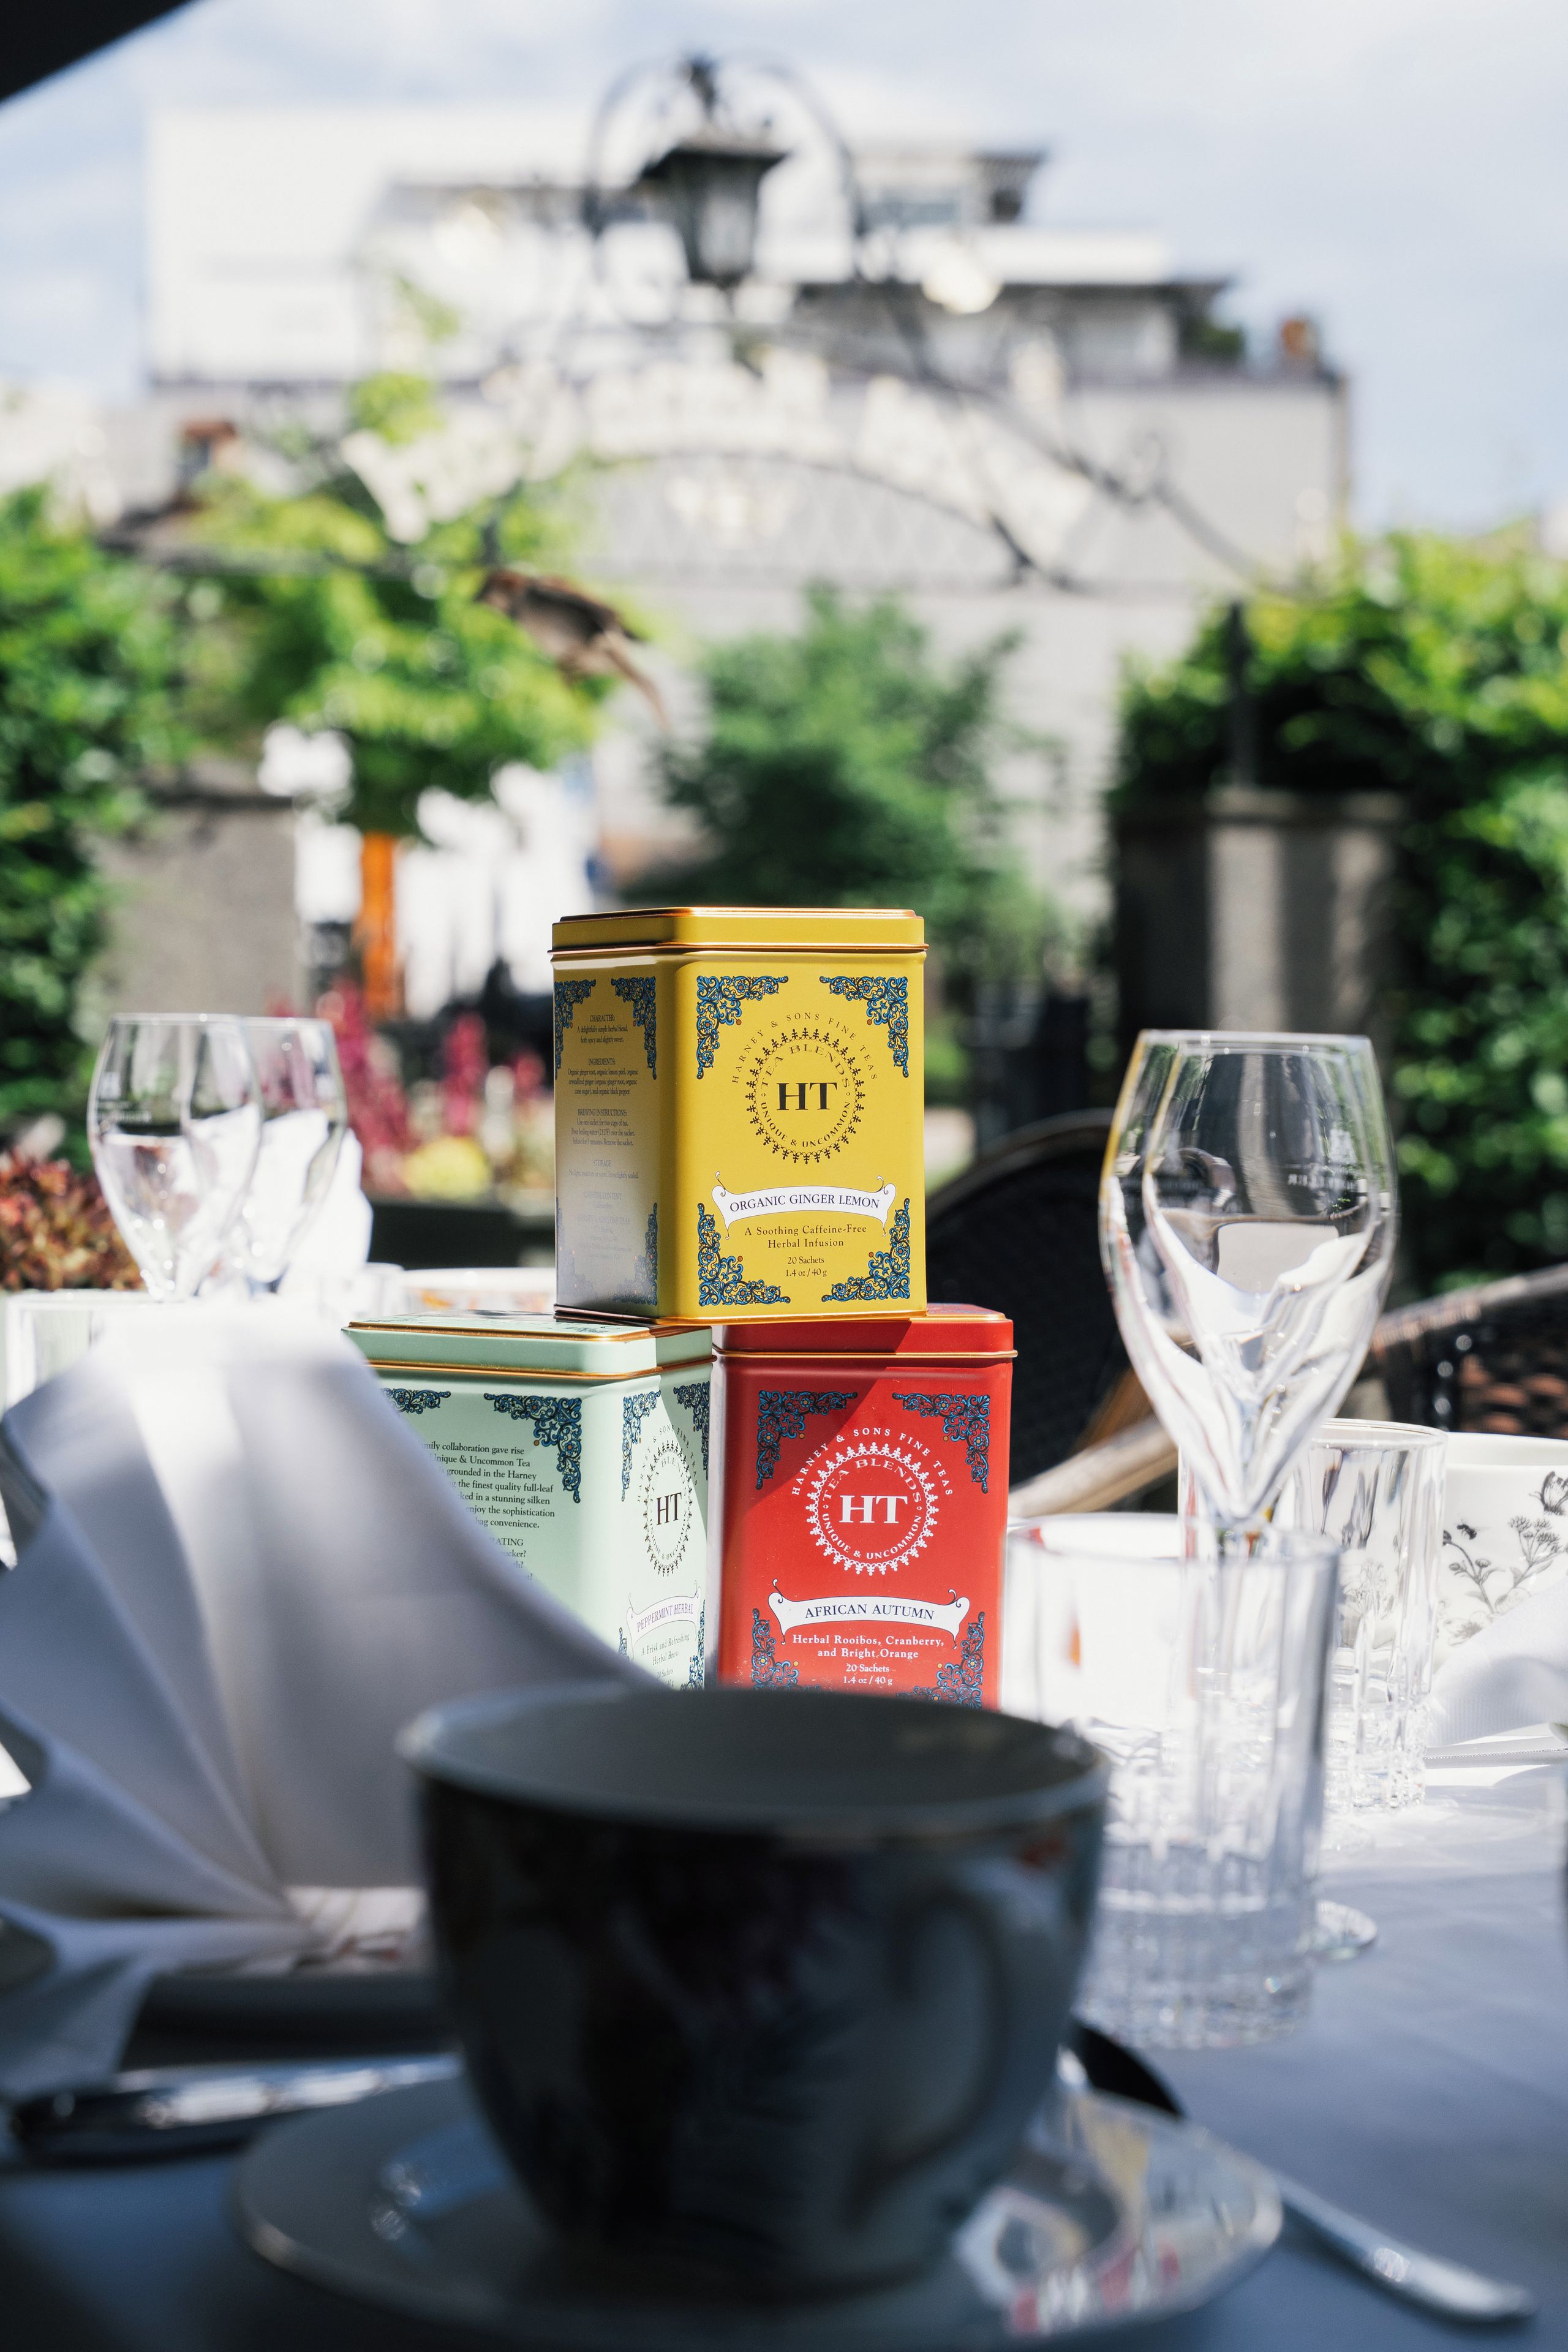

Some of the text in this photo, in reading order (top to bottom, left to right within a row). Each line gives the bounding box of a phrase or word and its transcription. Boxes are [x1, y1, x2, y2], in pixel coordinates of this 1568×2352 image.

[581, 1025, 598, 1034] delightfully
[598, 1025, 608, 1034] simple
[603, 1035, 614, 1044] slightly
[732, 1030, 764, 1084] HARNEY
[786, 1012, 820, 1021] SONS
[828, 1017, 856, 1040] FINE
[859, 1045, 877, 1080] TEAS
[627, 1068, 638, 1077] organic
[761, 1044, 850, 1089] TEA BLENDS
[776, 1082, 838, 1110] HT
[761, 1102, 788, 1142] UNIQUE
[802, 1101, 851, 1148] UNCOMMON
[729, 1194, 880, 1212] ORGANIC GINGER LEMON
[744, 1224, 867, 1237] A Soothing Caffeine-Free
[767, 1238, 845, 1249] Herbal Infusion
[799, 1256, 825, 1265] Sachets
[442, 1442, 489, 1453] collaboration
[459, 1455, 467, 1463] &
[469, 1455, 514, 1466] Uncommon
[516, 1458, 530, 1467] Tea
[791, 1443, 829, 1495] HARNEY
[853, 1427, 891, 1437] SONS
[899, 1433, 930, 1457] FINE
[933, 1460, 953, 1495] TEAS
[447, 1467, 481, 1477] grounded
[483, 1469, 492, 1477] in
[493, 1469, 506, 1478] the
[508, 1470, 537, 1482] Harney
[822, 1458, 922, 1503] TEA BLENDS
[458, 1479, 470, 1488] the
[472, 1479, 493, 1490] finest
[495, 1482, 521, 1493] quality
[523, 1483, 554, 1493] full-leaf
[475, 1492, 483, 1501] in
[491, 1495, 526, 1505] stunning
[527, 1496, 551, 1505] silken
[488, 1506, 500, 1514] the
[502, 1507, 556, 1517] sophistication
[656, 1491, 683, 1526] HT
[838, 1494, 908, 1524] HT
[490, 1520, 540, 1528] convenience.
[822, 1513, 851, 1553] UNIQUE
[865, 1515, 922, 1559] UNCOMMON
[637, 1603, 693, 1632] PEPPERMINT HERBAL
[804, 1604, 935, 1621] AFRICAN AUTUMN
[641, 1633, 690, 1656] A Brisk and Refreshing
[792, 1634, 944, 1647] Herbal Rooibos, Cranberry,
[652, 1650, 678, 1666] Herbal Brew
[817, 1648, 919, 1659] and Bright Orange
[845, 1663, 890, 1673] 20 Sachets
[843, 1676, 856, 1684] 1.4
[874, 1676, 886, 1685] 40
